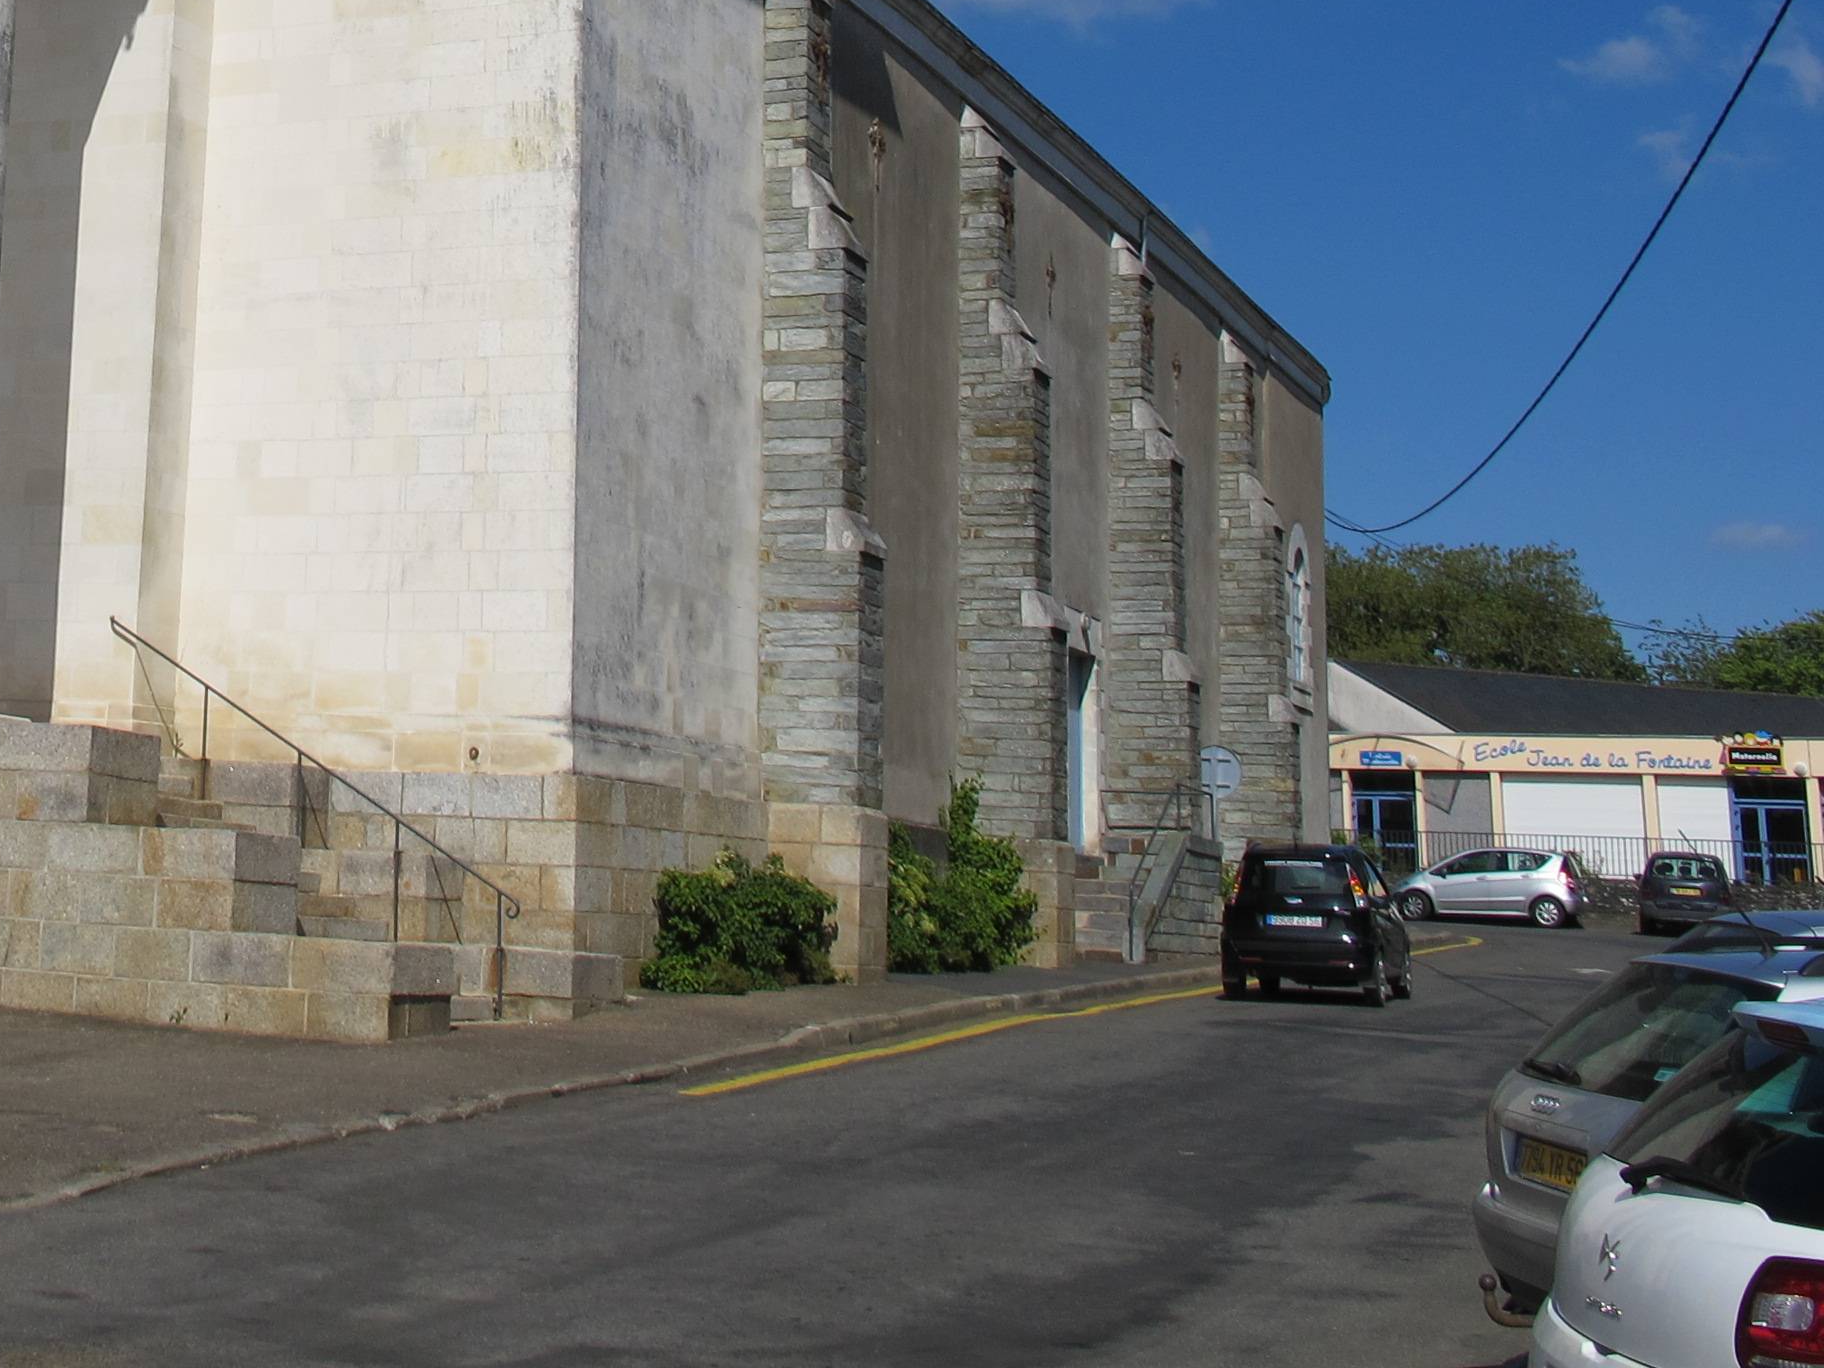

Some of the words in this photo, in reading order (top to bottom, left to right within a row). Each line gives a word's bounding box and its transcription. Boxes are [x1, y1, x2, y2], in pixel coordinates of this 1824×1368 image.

[1473, 739, 1526, 762] Ecole
[1527, 749, 1573, 767] Jean
[1580, 753, 1601, 767] de
[1608, 753, 1628, 768] la
[1635, 750, 1712, 769] Fontaine
